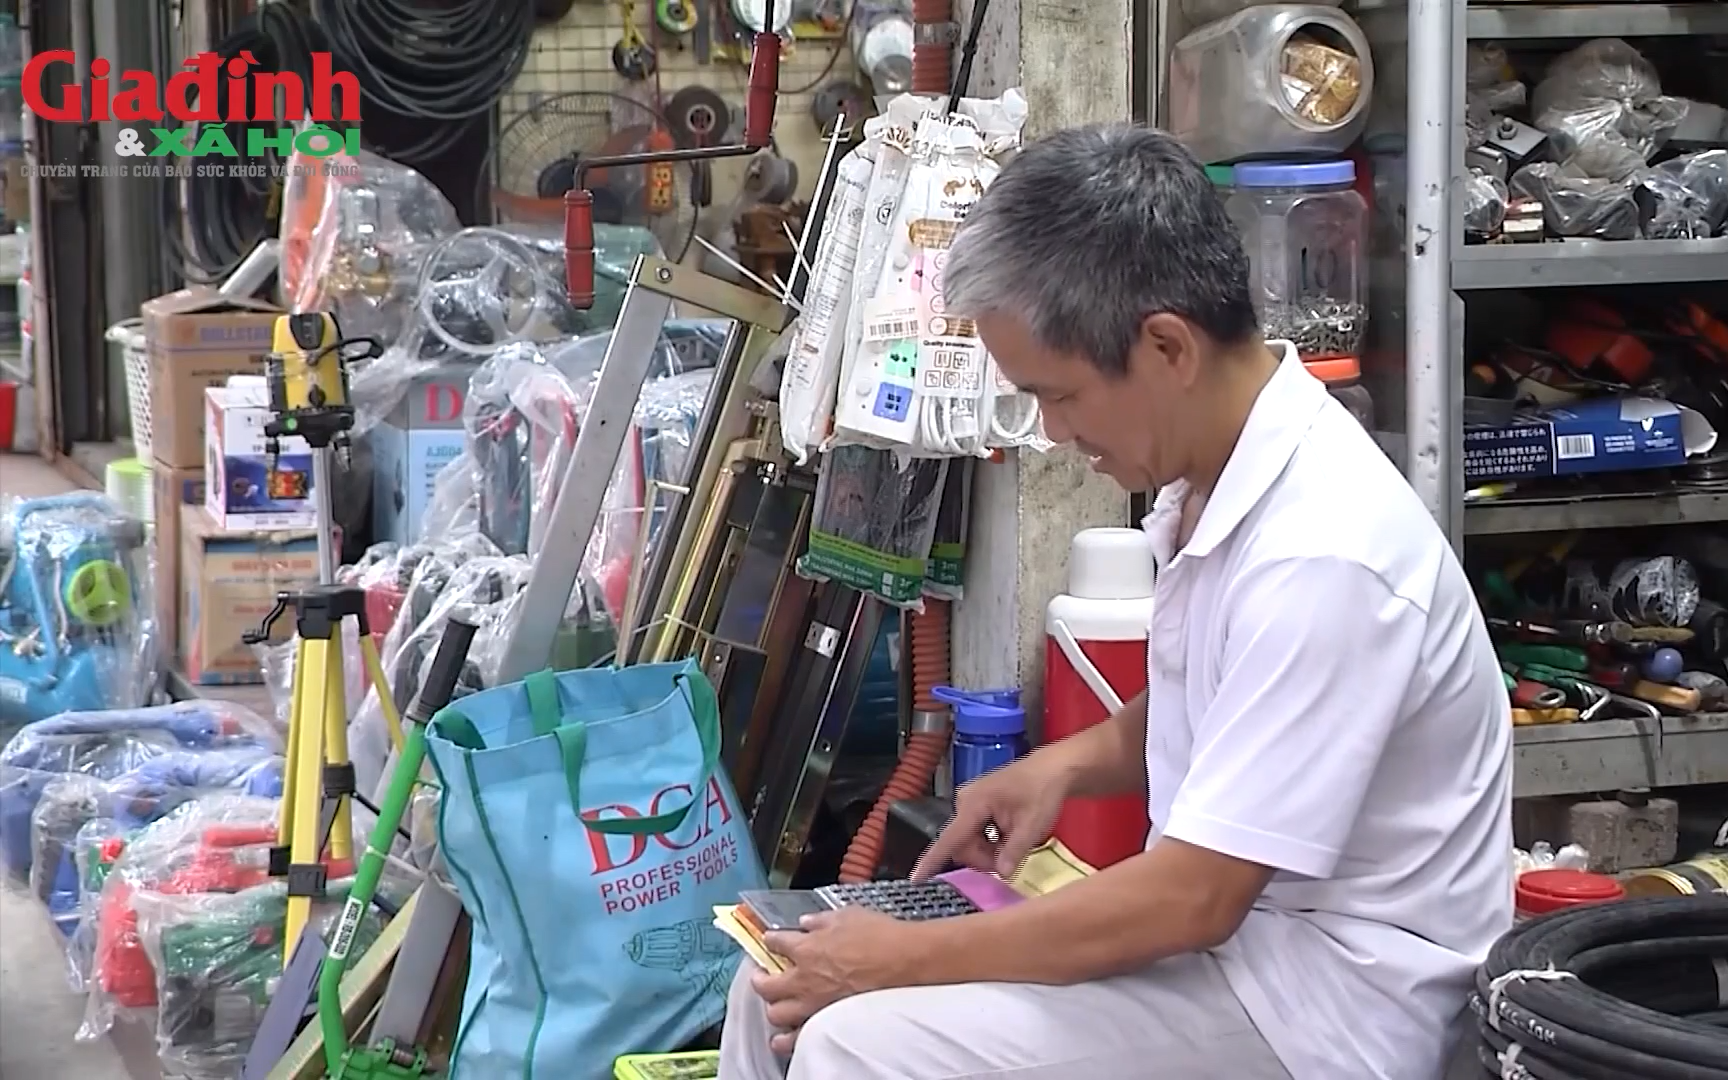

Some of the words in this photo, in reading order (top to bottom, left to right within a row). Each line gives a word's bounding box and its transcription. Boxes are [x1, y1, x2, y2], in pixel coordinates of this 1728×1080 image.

[580, 774, 732, 876] DCA
[601, 831, 736, 898] PROFESSIONAL
[606, 880, 681, 915] POWER
[692, 847, 738, 885] TOOLS
